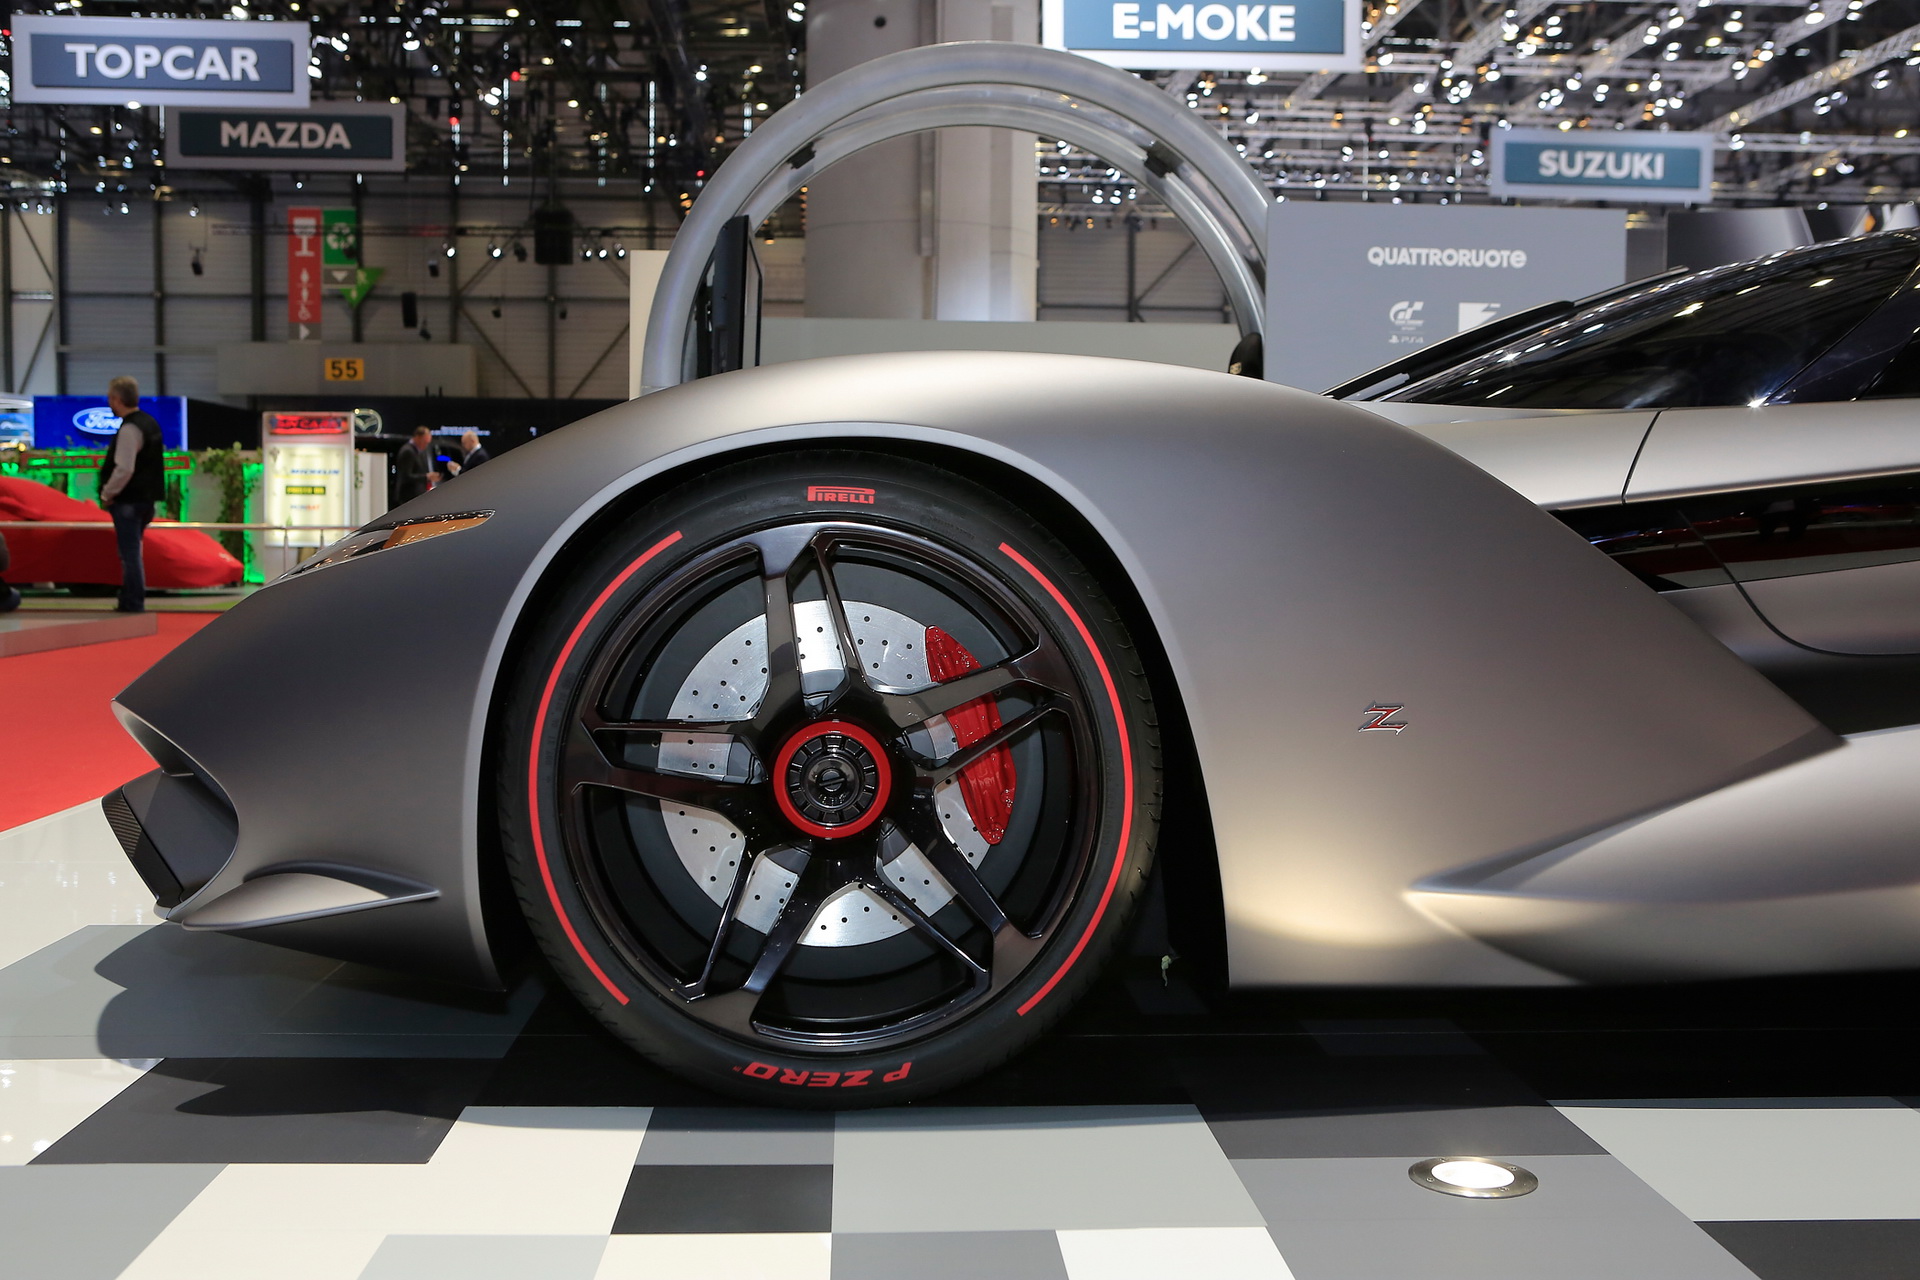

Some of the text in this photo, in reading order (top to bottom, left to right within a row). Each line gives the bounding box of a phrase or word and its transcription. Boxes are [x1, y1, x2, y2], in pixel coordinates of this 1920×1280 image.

[1112, 2, 1296, 42] E-MOKE
[64, 42, 261, 82] TOPCAR
[220, 120, 352, 150] MAZDA
[1538, 149, 1665, 181] SUZUKI
[331, 360, 358, 379] 55
[807, 485, 876, 504] PIRELLI
[1358, 702, 1408, 735] Z
[742, 1061, 874, 1087] ZERO
[882, 1061, 912, 1083] P
